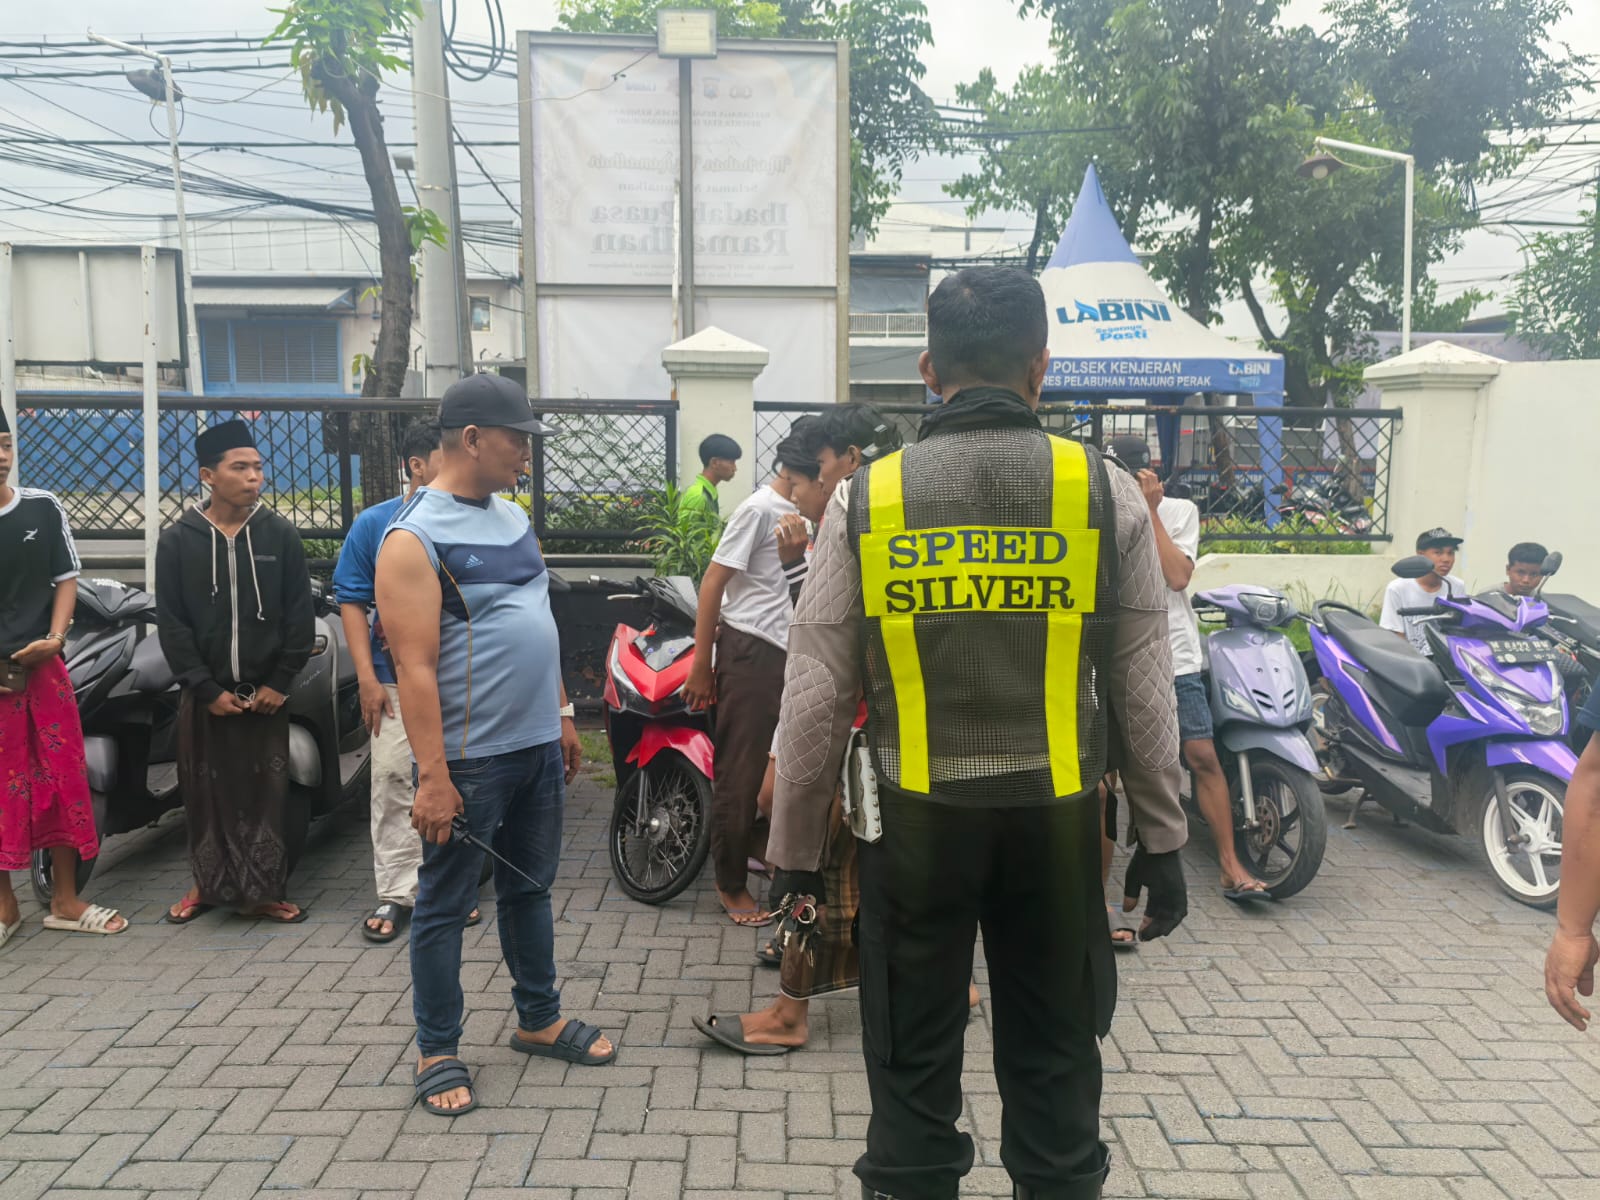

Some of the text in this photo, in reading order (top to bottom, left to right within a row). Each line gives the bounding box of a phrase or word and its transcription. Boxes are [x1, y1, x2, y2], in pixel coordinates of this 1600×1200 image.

[1056, 299, 1172, 324] LABINI
[1053, 361, 1182, 374] POLSEK KENJERAN
[1042, 375, 1211, 387] RES PELABUHAN TANJUNG PERAK
[888, 530, 1068, 569] SPEED
[885, 575, 1075, 613] SILVER
